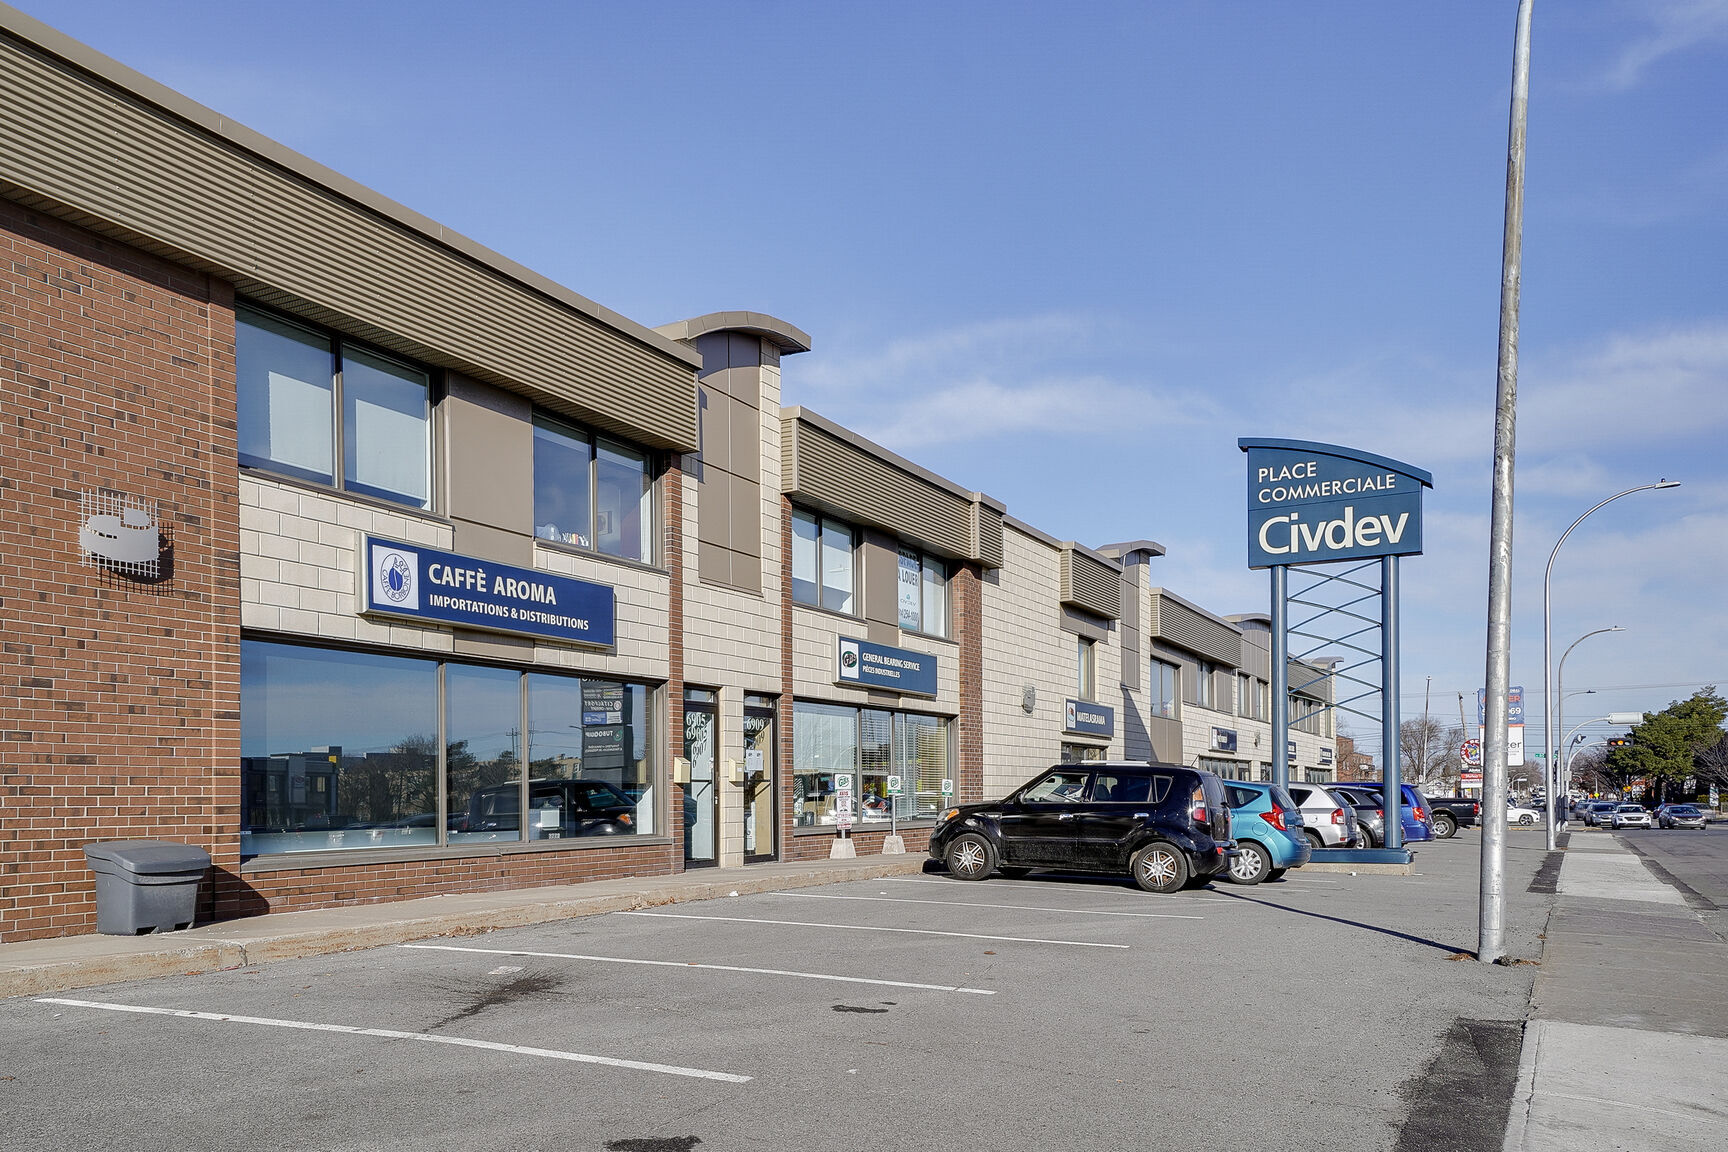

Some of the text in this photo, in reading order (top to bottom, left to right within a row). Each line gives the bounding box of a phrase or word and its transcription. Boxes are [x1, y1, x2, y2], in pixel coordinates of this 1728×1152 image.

[1258, 461, 1317, 483] PLACE
[1258, 474, 1396, 503] COMMERCIALE
[1258, 506, 1410, 554] Civdev
[428, 563, 557, 605] CAFFÈ AROMA
[429, 594, 589, 630] IMPORTATIONS & DISTRIBUTIONS
[862, 652, 921, 671] GENERAL BEARING SERVICE
[746, 717, 764, 731] 6909
